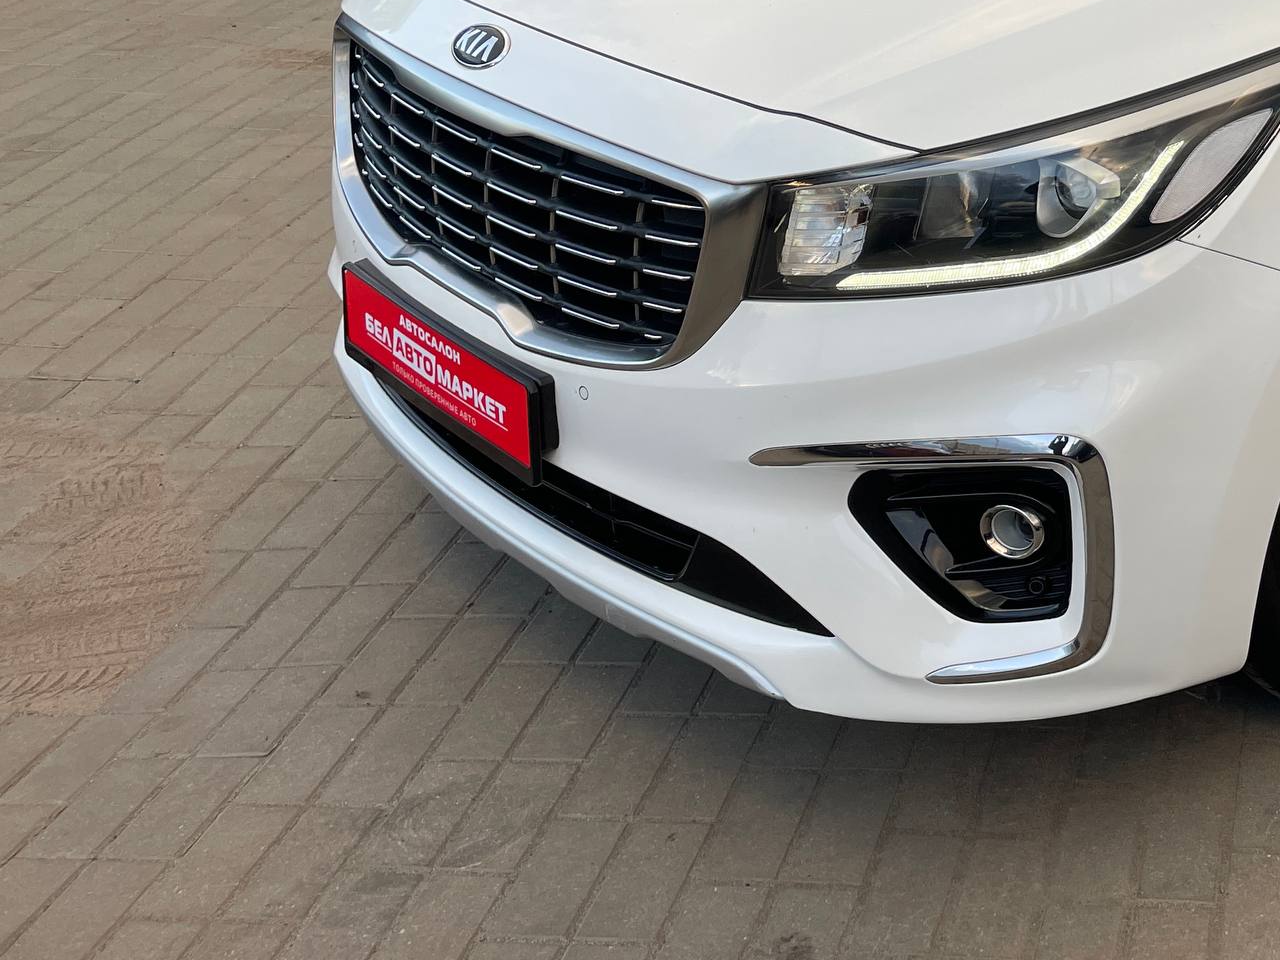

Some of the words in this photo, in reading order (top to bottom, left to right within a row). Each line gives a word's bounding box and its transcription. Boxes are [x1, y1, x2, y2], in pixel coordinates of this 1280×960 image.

[364, 312, 393, 349] БЕЛ
[394, 332, 434, 378] АВТО
[436, 364, 507, 425] МАРКЕТ
[399, 314, 461, 366] АВТОСАЛОН
[392, 361, 415, 384] ТОЛЬКО
[459, 410, 477, 427] АВТО
